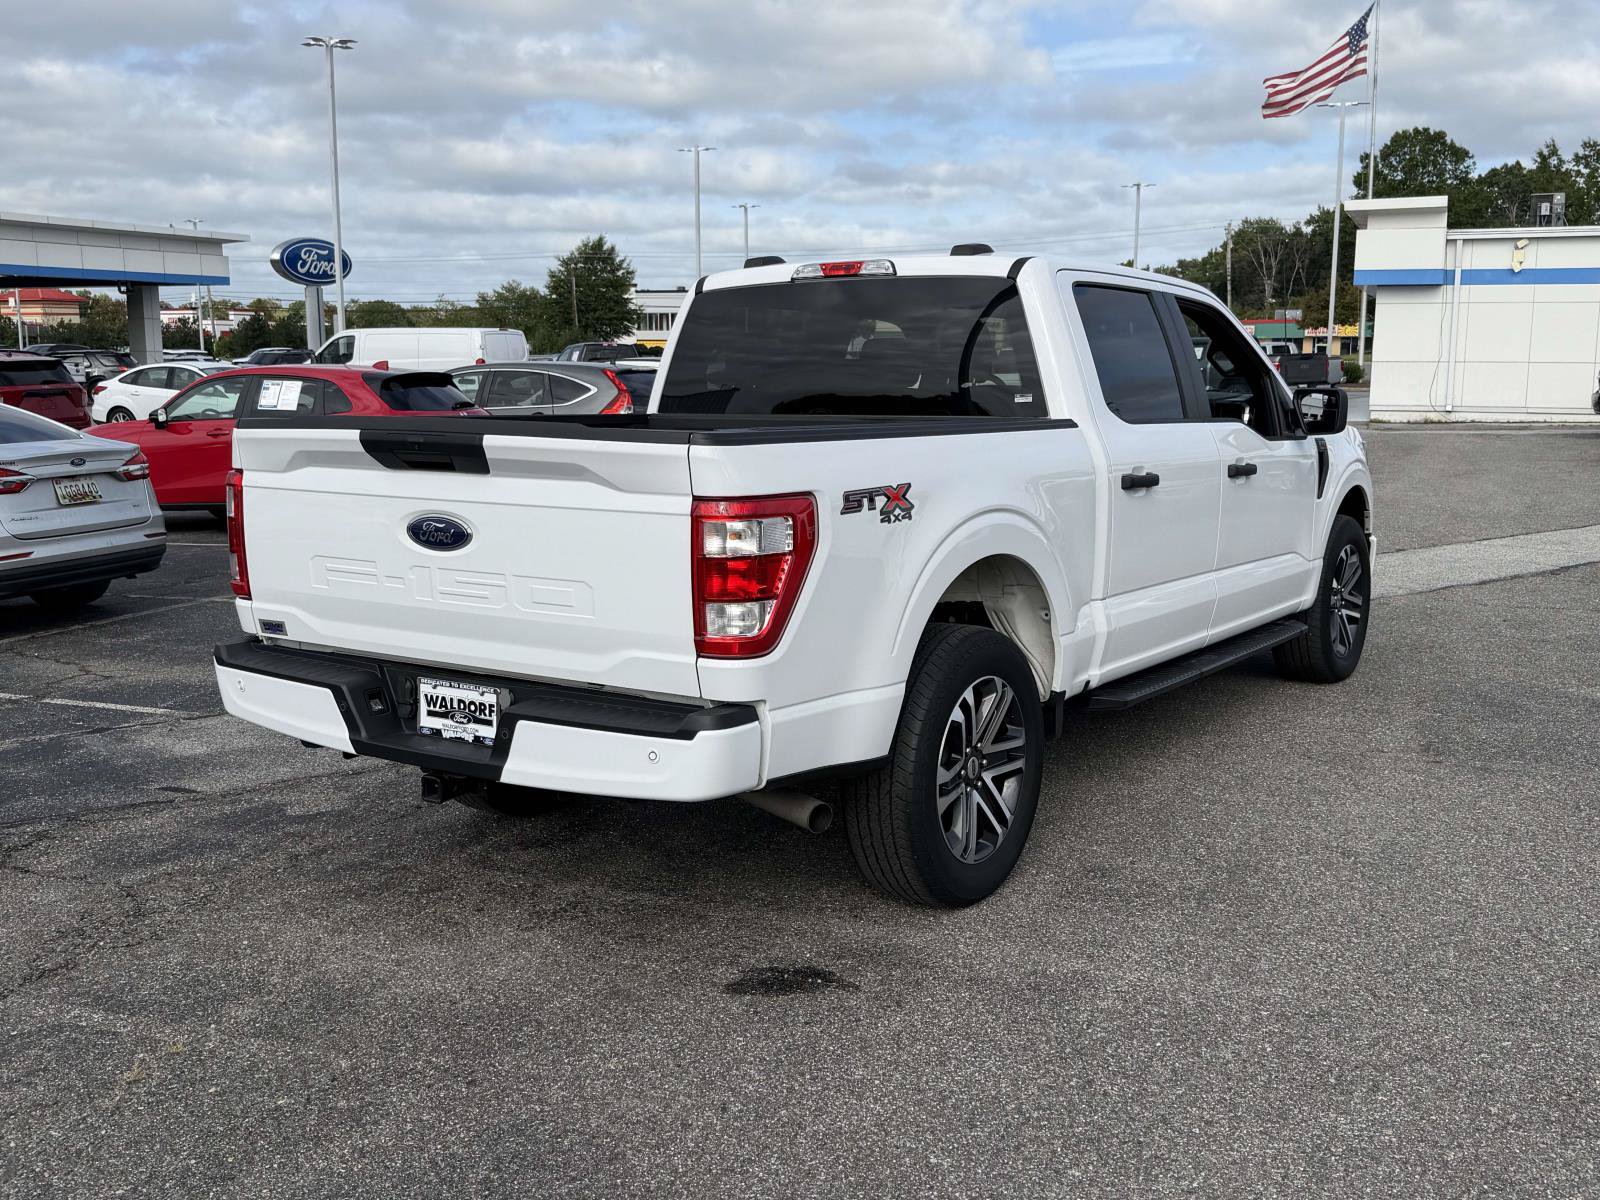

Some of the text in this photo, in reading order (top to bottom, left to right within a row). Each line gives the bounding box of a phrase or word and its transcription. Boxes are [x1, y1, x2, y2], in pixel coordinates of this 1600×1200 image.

[840, 482, 915, 516] STX
[420, 521, 454, 543] Ford
[309, 554, 596, 619] F-150
[420, 678, 451, 687] DEDICATED
[460, 684, 495, 694] EXCELLENCE
[424, 693, 496, 718] WALDORF
[453, 713, 469, 724] Ford
